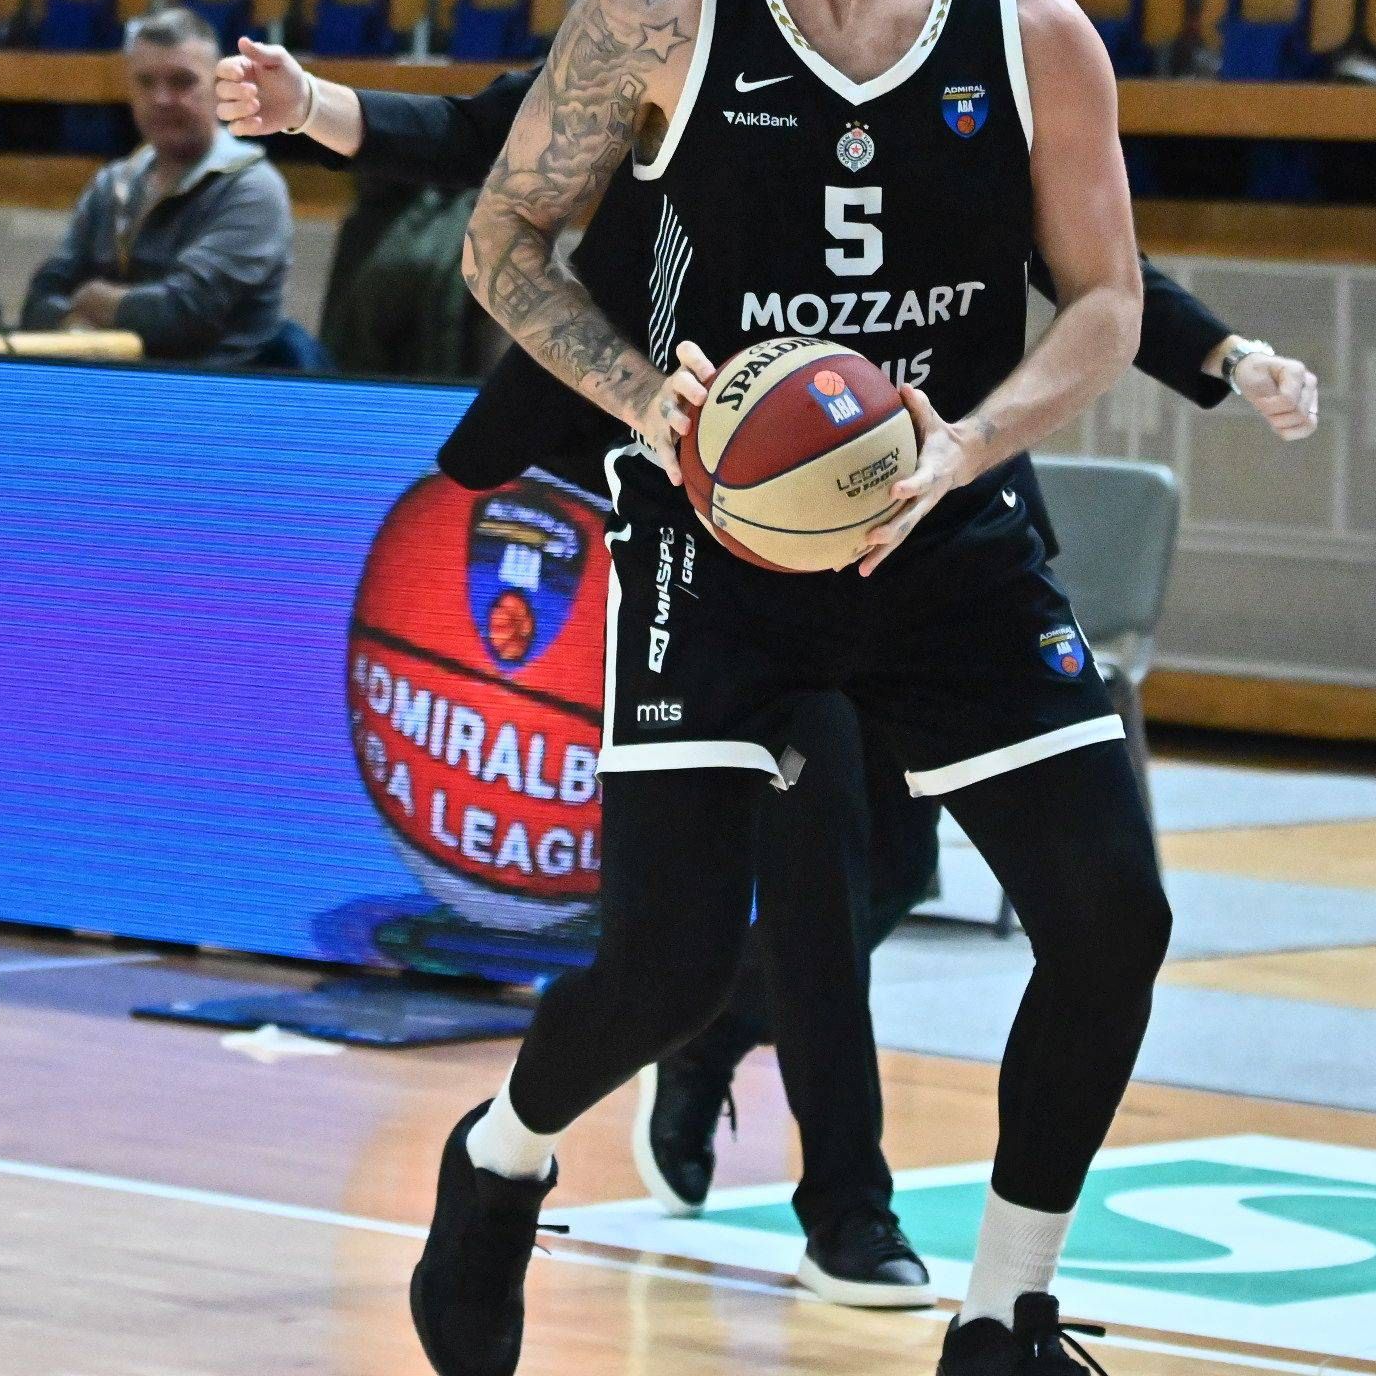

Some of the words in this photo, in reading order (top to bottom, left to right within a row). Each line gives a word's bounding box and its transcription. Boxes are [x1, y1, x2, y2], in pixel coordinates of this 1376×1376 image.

[944, 84, 985, 94] ADMIRAL
[734, 110, 798, 127] AikBank
[957, 100, 974, 113] ABA
[825, 186, 883, 276] 5
[741, 281, 985, 335] MOZZART
[827, 393, 861, 423] ABA
[837, 447, 899, 491] LEGACY
[636, 700, 682, 722] mts
